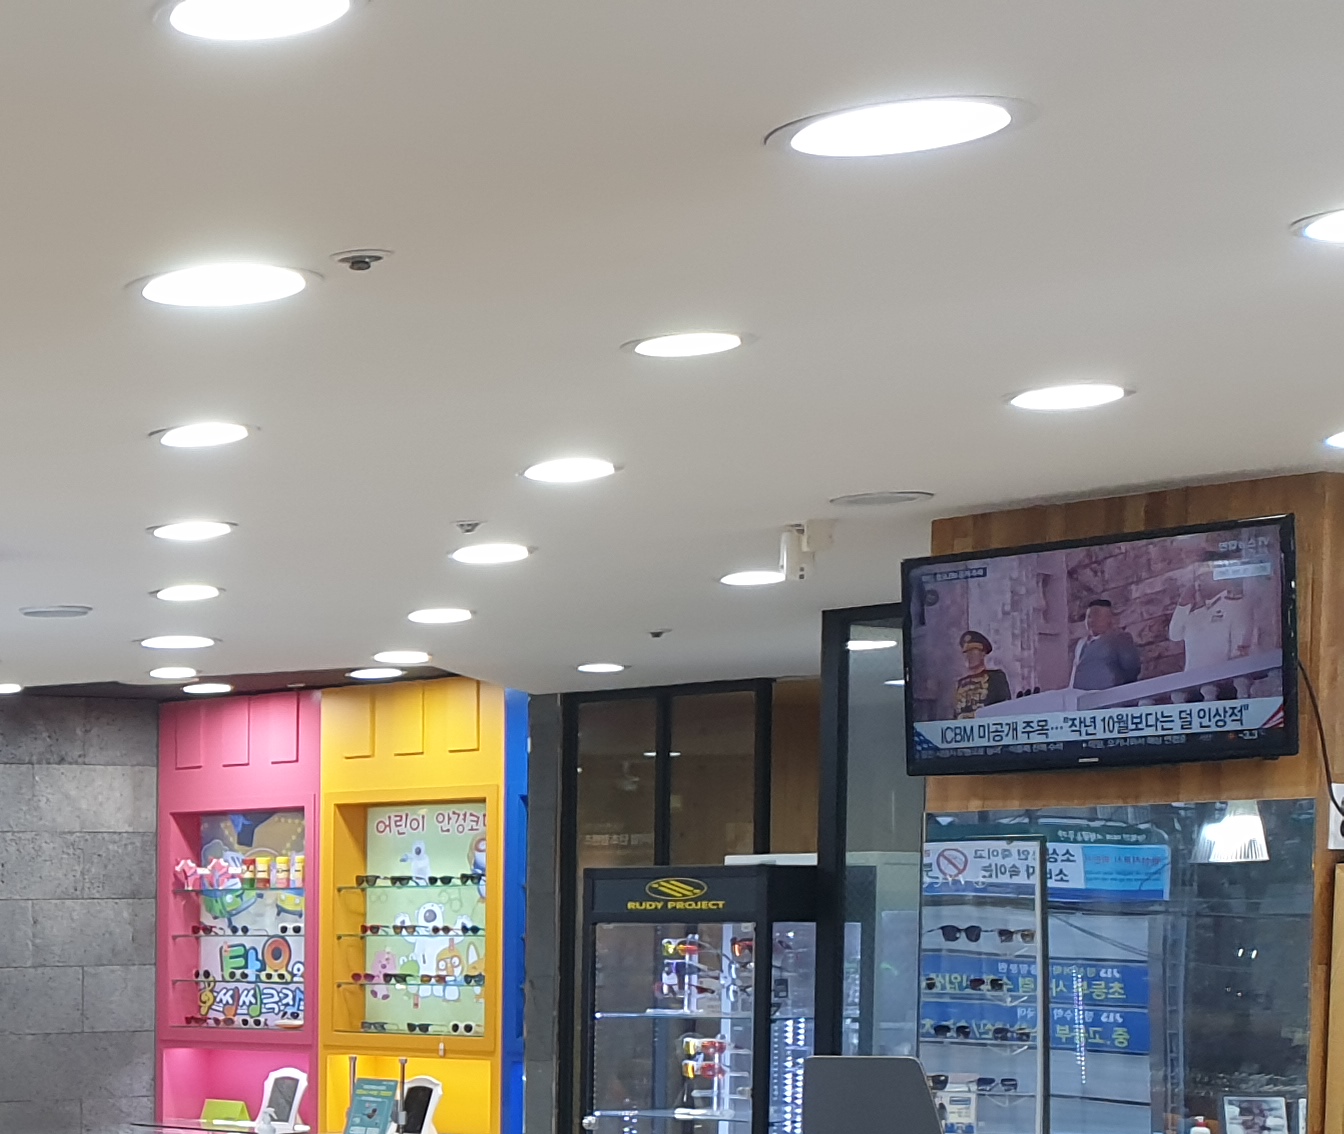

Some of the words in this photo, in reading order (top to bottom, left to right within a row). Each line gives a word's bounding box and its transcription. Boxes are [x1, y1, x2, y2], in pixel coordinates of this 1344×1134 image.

[940, 727, 974, 744] ICBM
[978, 721, 1019, 743] 미공개
[1100, 710, 1175, 735] 10월보다는
[1178, 707, 1194, 731] 덜
[375, 812, 426, 836] 어린이
[435, 810, 486, 834] 안경코
[626, 899, 664, 911] RUDY
[667, 899, 726, 910] PROJECT
